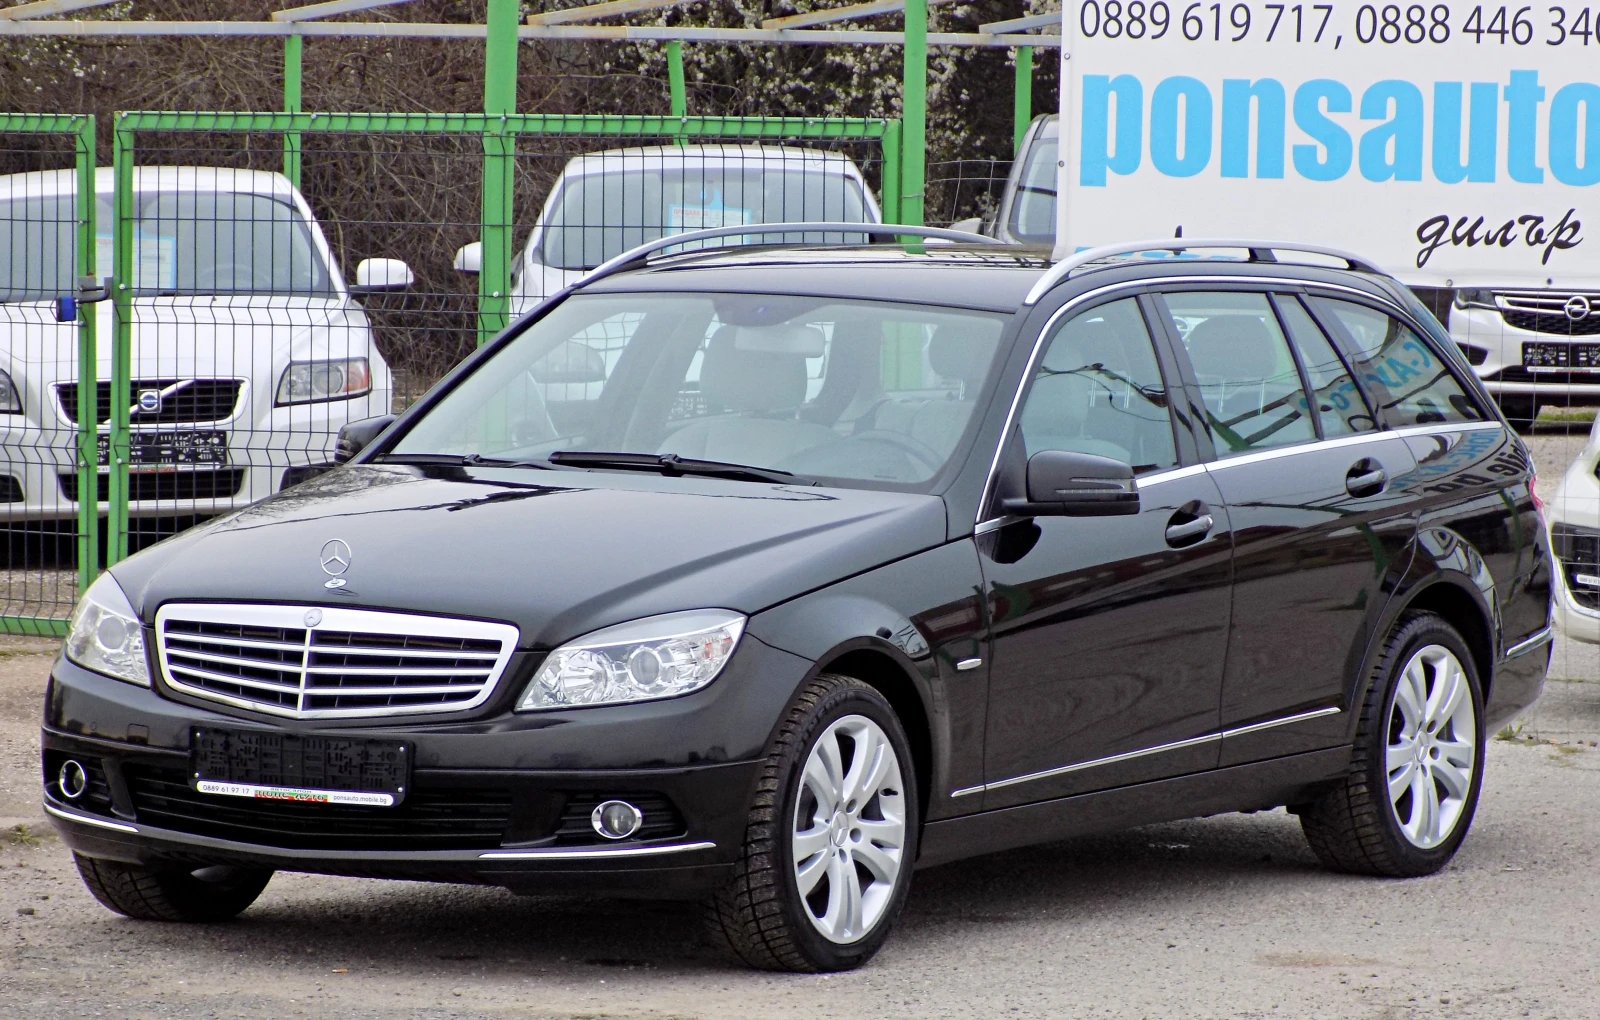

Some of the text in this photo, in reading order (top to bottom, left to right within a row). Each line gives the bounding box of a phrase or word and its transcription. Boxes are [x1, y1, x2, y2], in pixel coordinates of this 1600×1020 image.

[1080, 0, 1600, 49] 0889 619 717, 0888 446 34
[1079, 69, 1600, 187] ponsauto
[1416, 208, 1584, 269] дилър
[202, 784, 220, 792] 0889
